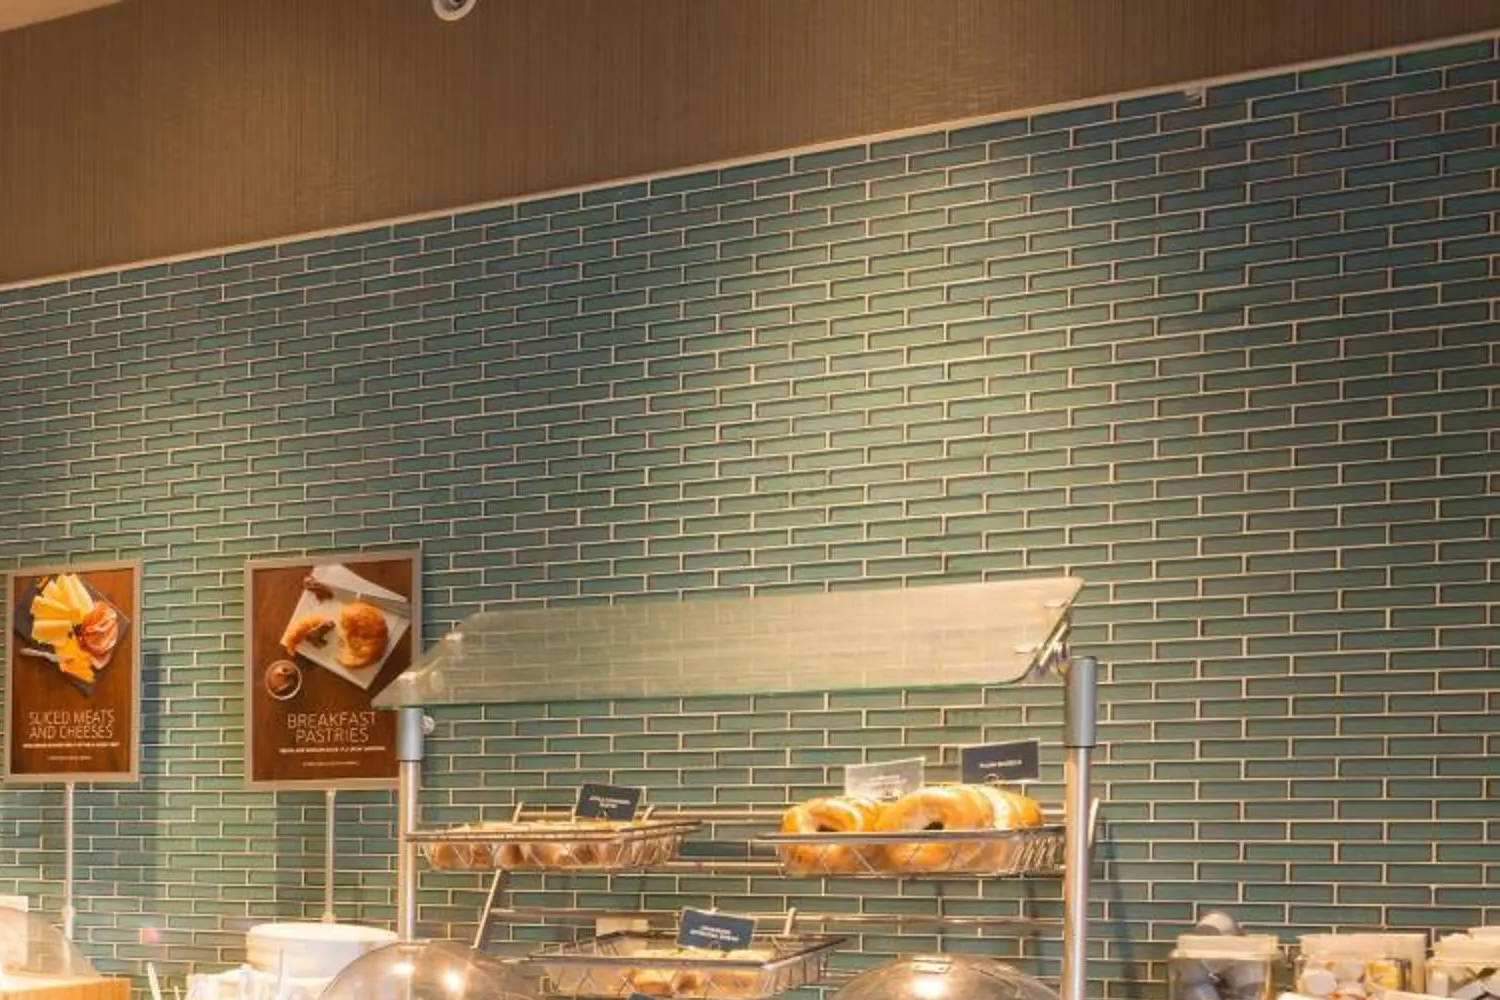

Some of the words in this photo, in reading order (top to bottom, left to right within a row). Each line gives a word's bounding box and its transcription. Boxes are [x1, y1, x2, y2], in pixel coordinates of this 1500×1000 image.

[28, 710, 71, 725] SLICED
[73, 709, 115, 725] MEATS
[287, 711, 376, 729] BREAKFAST
[29, 726, 56, 739] AND
[59, 724, 113, 739] CHEESES
[295, 727, 370, 744] PASTRIES
